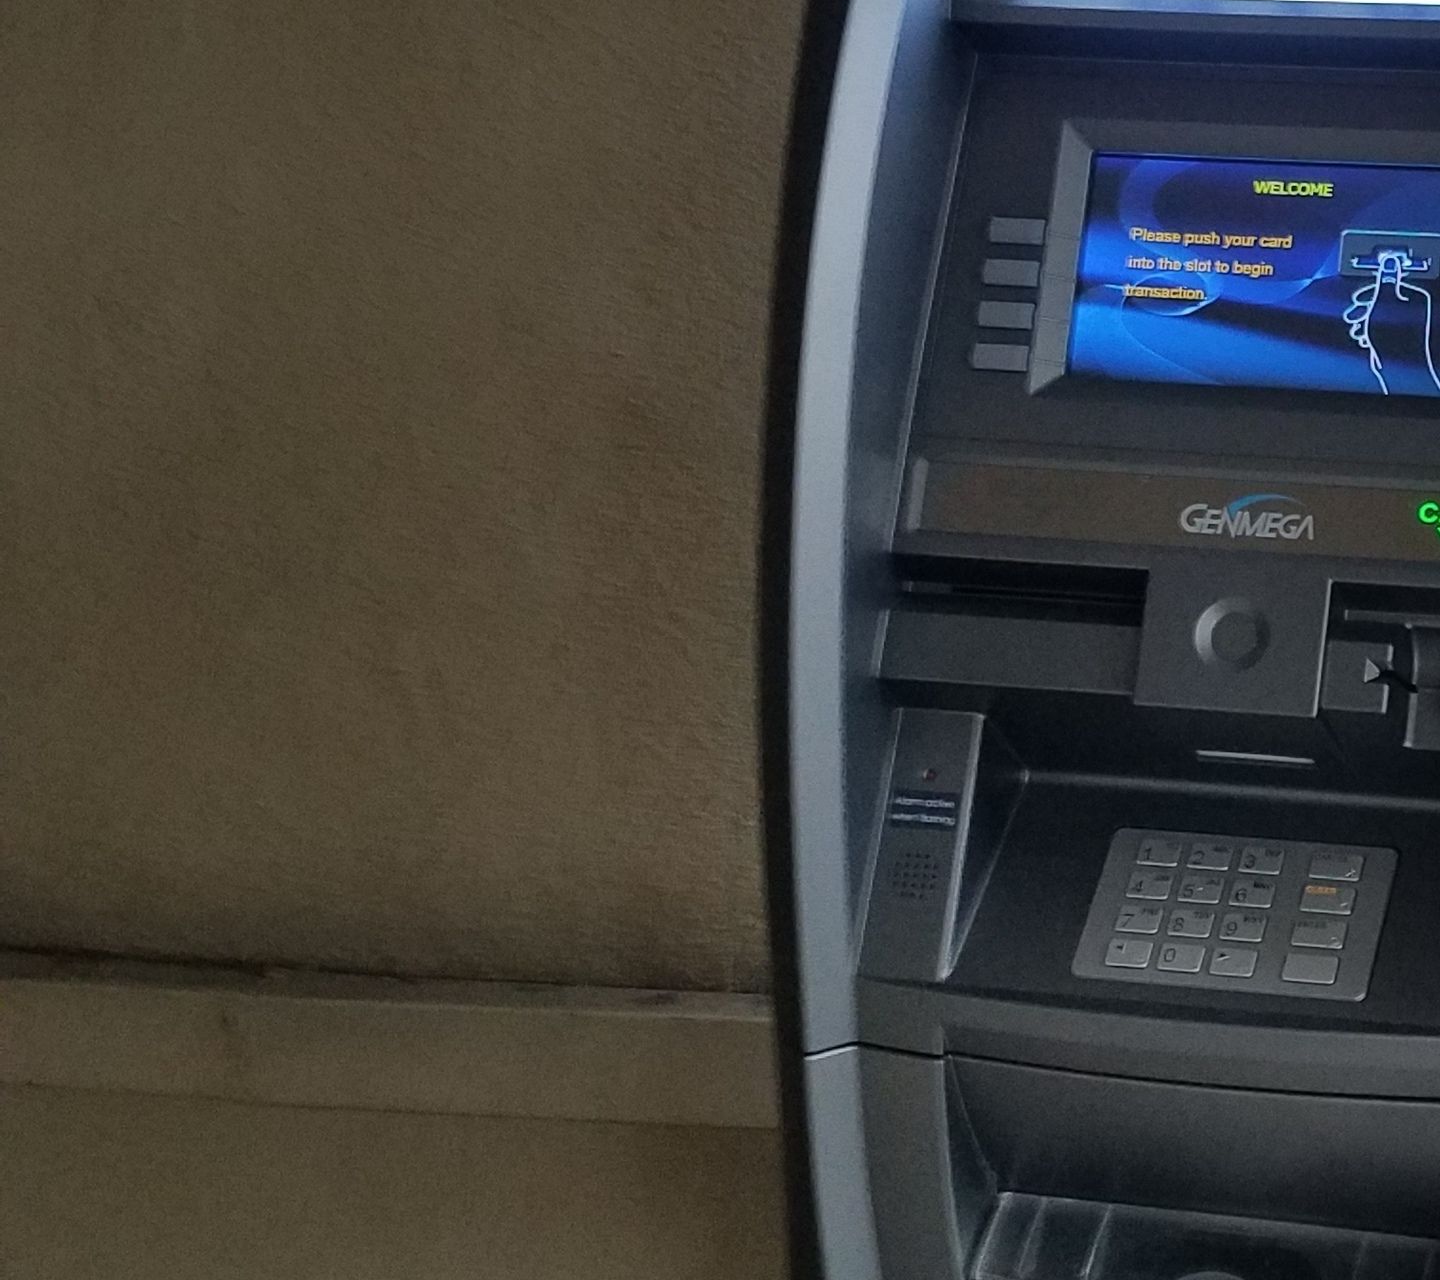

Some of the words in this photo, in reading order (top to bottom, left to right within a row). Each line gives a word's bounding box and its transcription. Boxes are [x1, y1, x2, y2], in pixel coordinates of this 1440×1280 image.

[1253, 180, 1334, 197] WELCOME
[1129, 227, 1181, 243] Please
[1183, 232, 1220, 247] push
[1223, 235, 1257, 249] your
[1259, 235, 1293, 249] card
[1127, 256, 1154, 269] into
[1158, 257, 1181, 271] the
[1185, 258, 1212, 272] slot
[1215, 261, 1229, 273] to
[1232, 262, 1274, 278] begin
[1124, 283, 1207, 300] transaction.
[1180, 503, 1315, 540] GENMEGA
[1144, 847, 1152, 861] 1
[1191, 850, 1205, 865] 2
[1244, 854, 1256, 869] 3
[1134, 880, 1144, 892] 4
[1183, 884, 1195, 898] 5
[1235, 888, 1247, 902] 6
[1121, 913, 1134, 928] 7
[1172, 917, 1185, 932] 8
[1226, 921, 1238, 936] 9
[1163, 948, 1176, 963] 0
